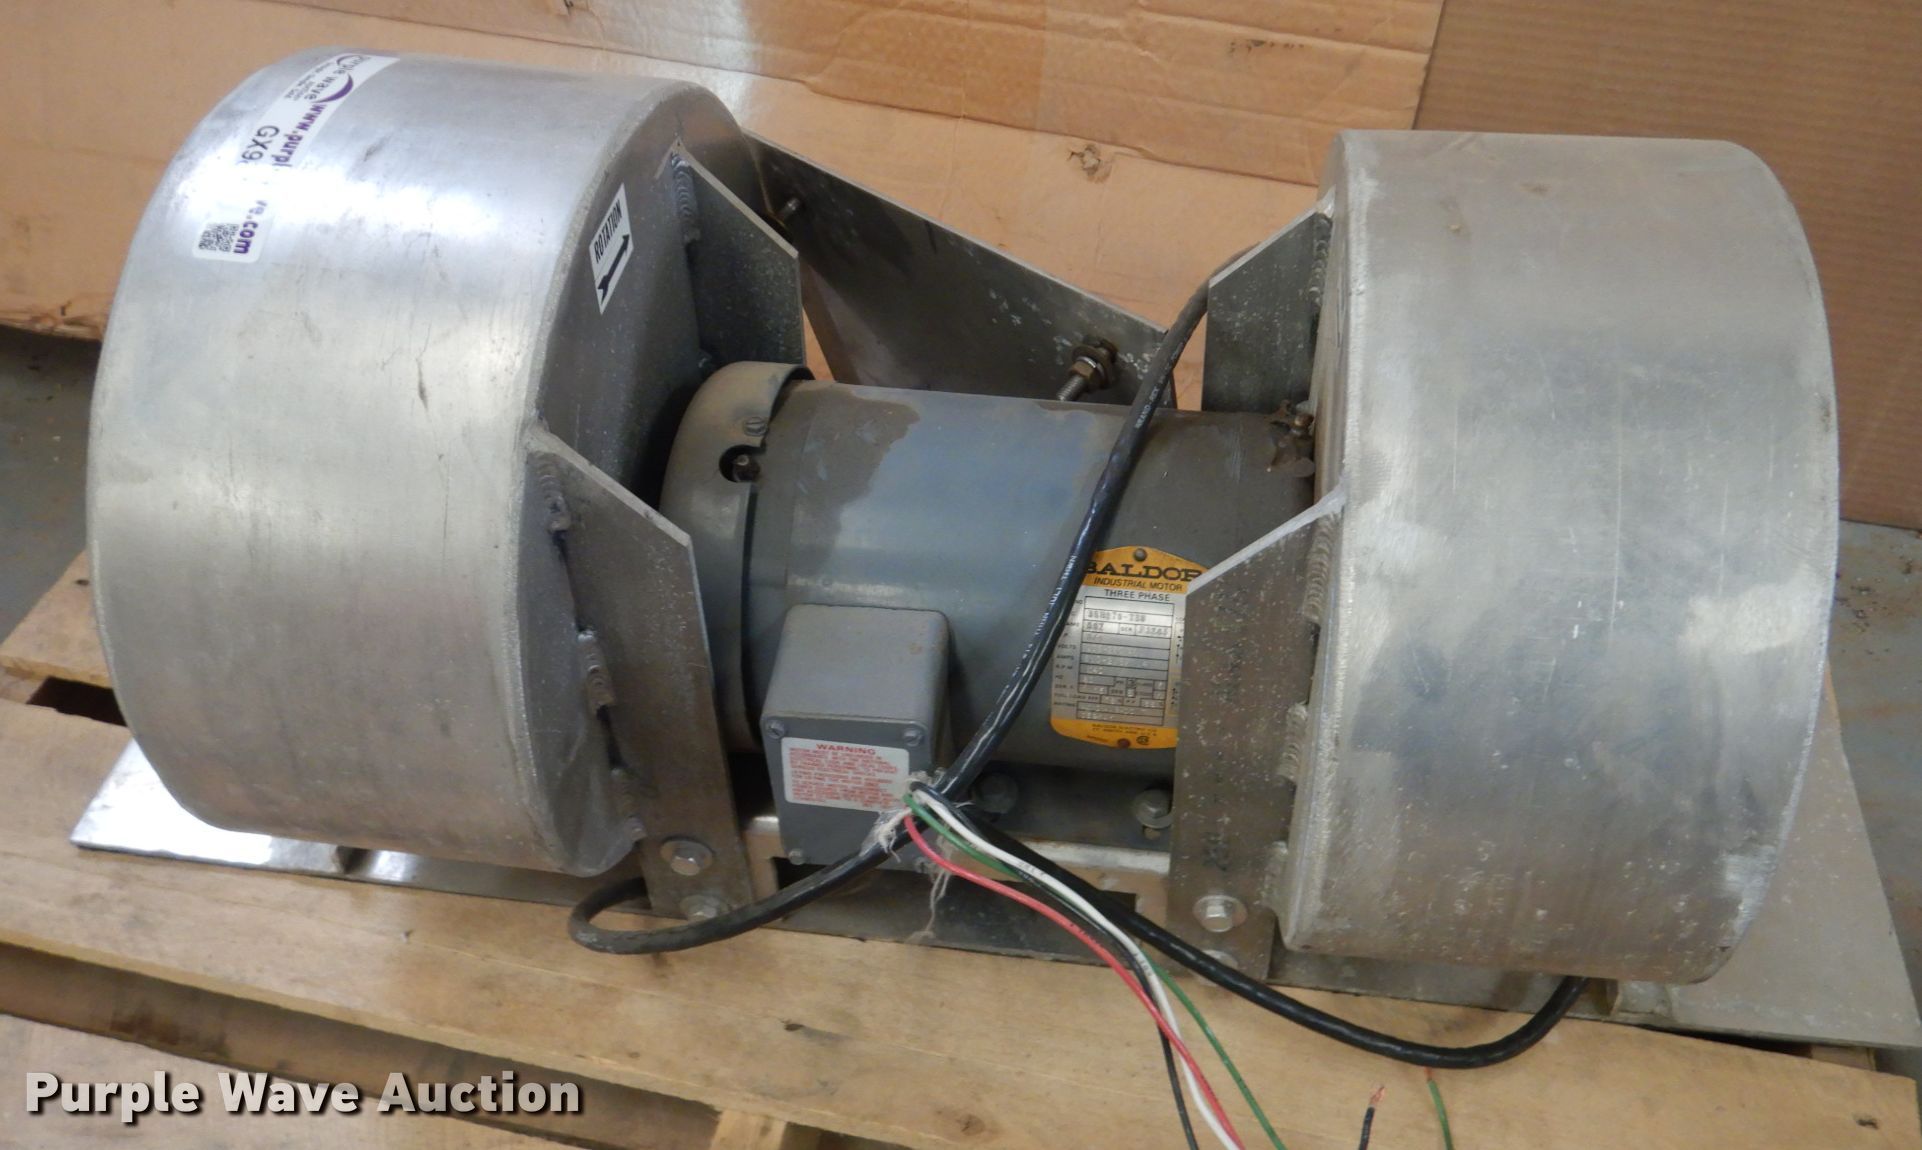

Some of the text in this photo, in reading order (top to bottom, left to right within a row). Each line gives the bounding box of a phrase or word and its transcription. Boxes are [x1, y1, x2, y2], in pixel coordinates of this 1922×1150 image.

[593, 200, 622, 264] ROTATION
[1094, 577, 1182, 592] INDUSTRIAL MOTOR
[1104, 588, 1170, 602] THREE PHASE
[816, 743, 876, 756] WARNING
